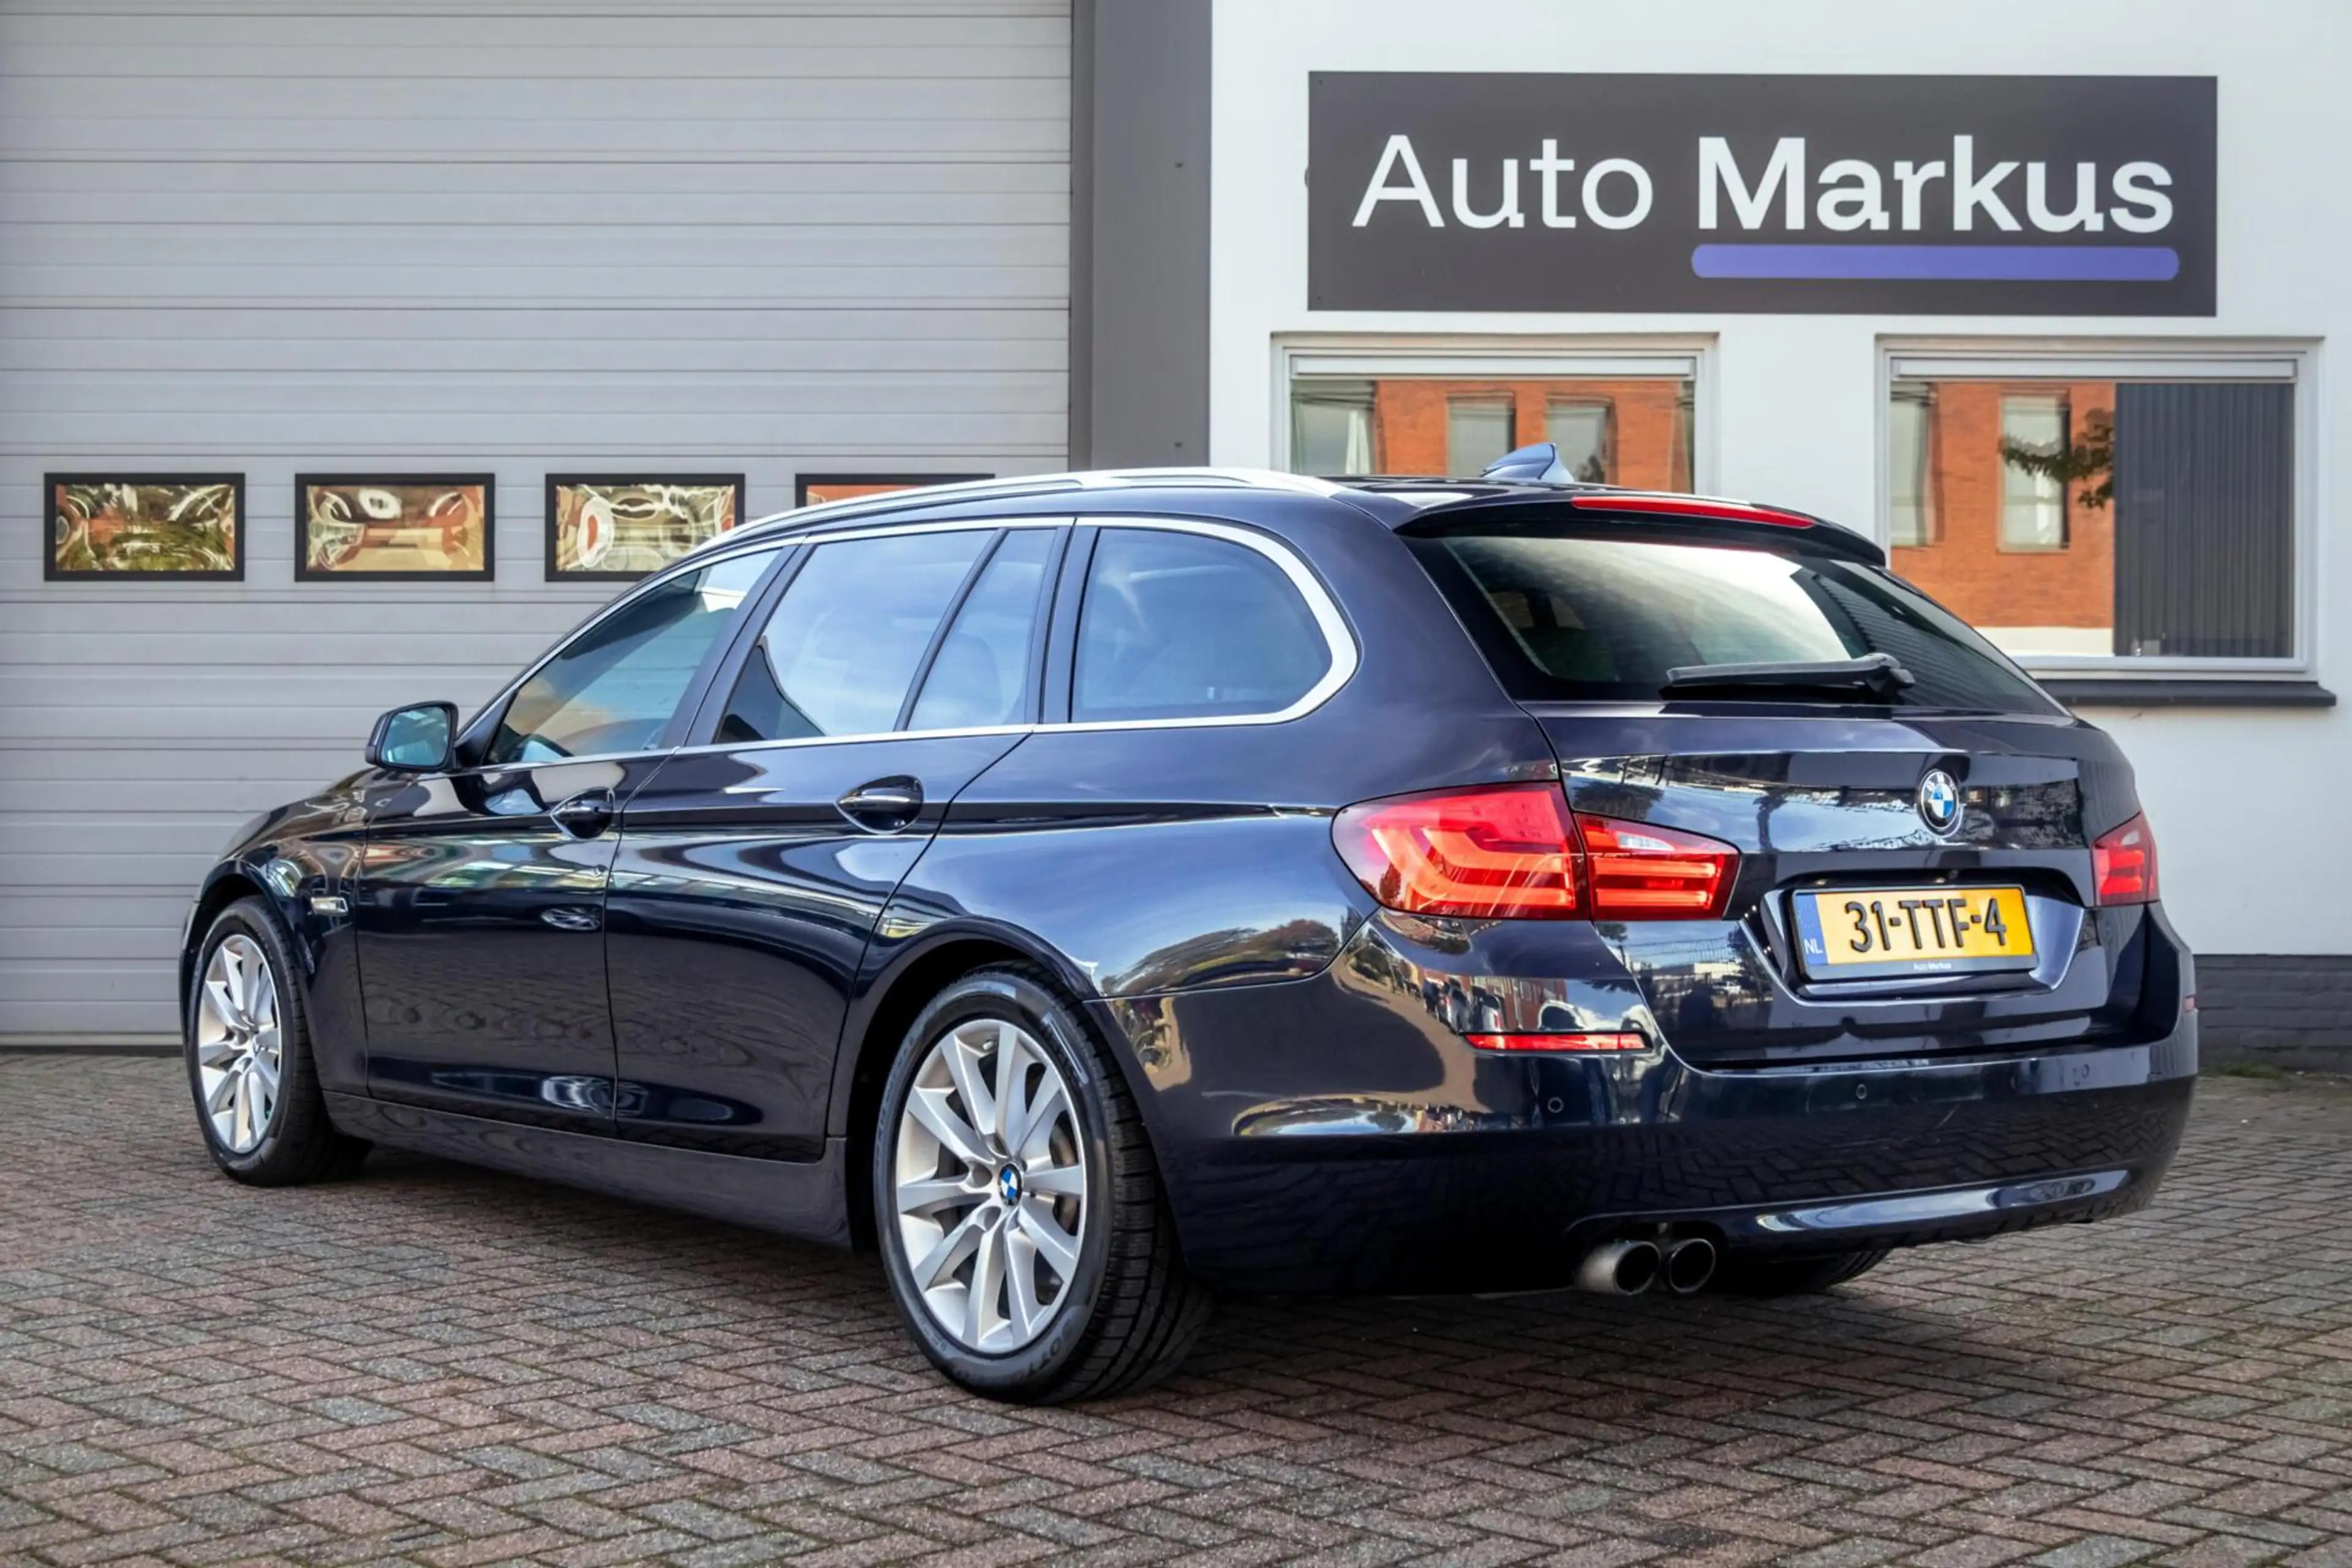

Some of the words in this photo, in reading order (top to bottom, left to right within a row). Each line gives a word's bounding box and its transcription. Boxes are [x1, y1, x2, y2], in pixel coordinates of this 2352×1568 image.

[1351, 134, 1653, 230] Auto
[1698, 134, 2173, 233] Markus
[1803, 938, 1823, 954] NL
[1844, 897, 2007, 953] 31-TTF-4
